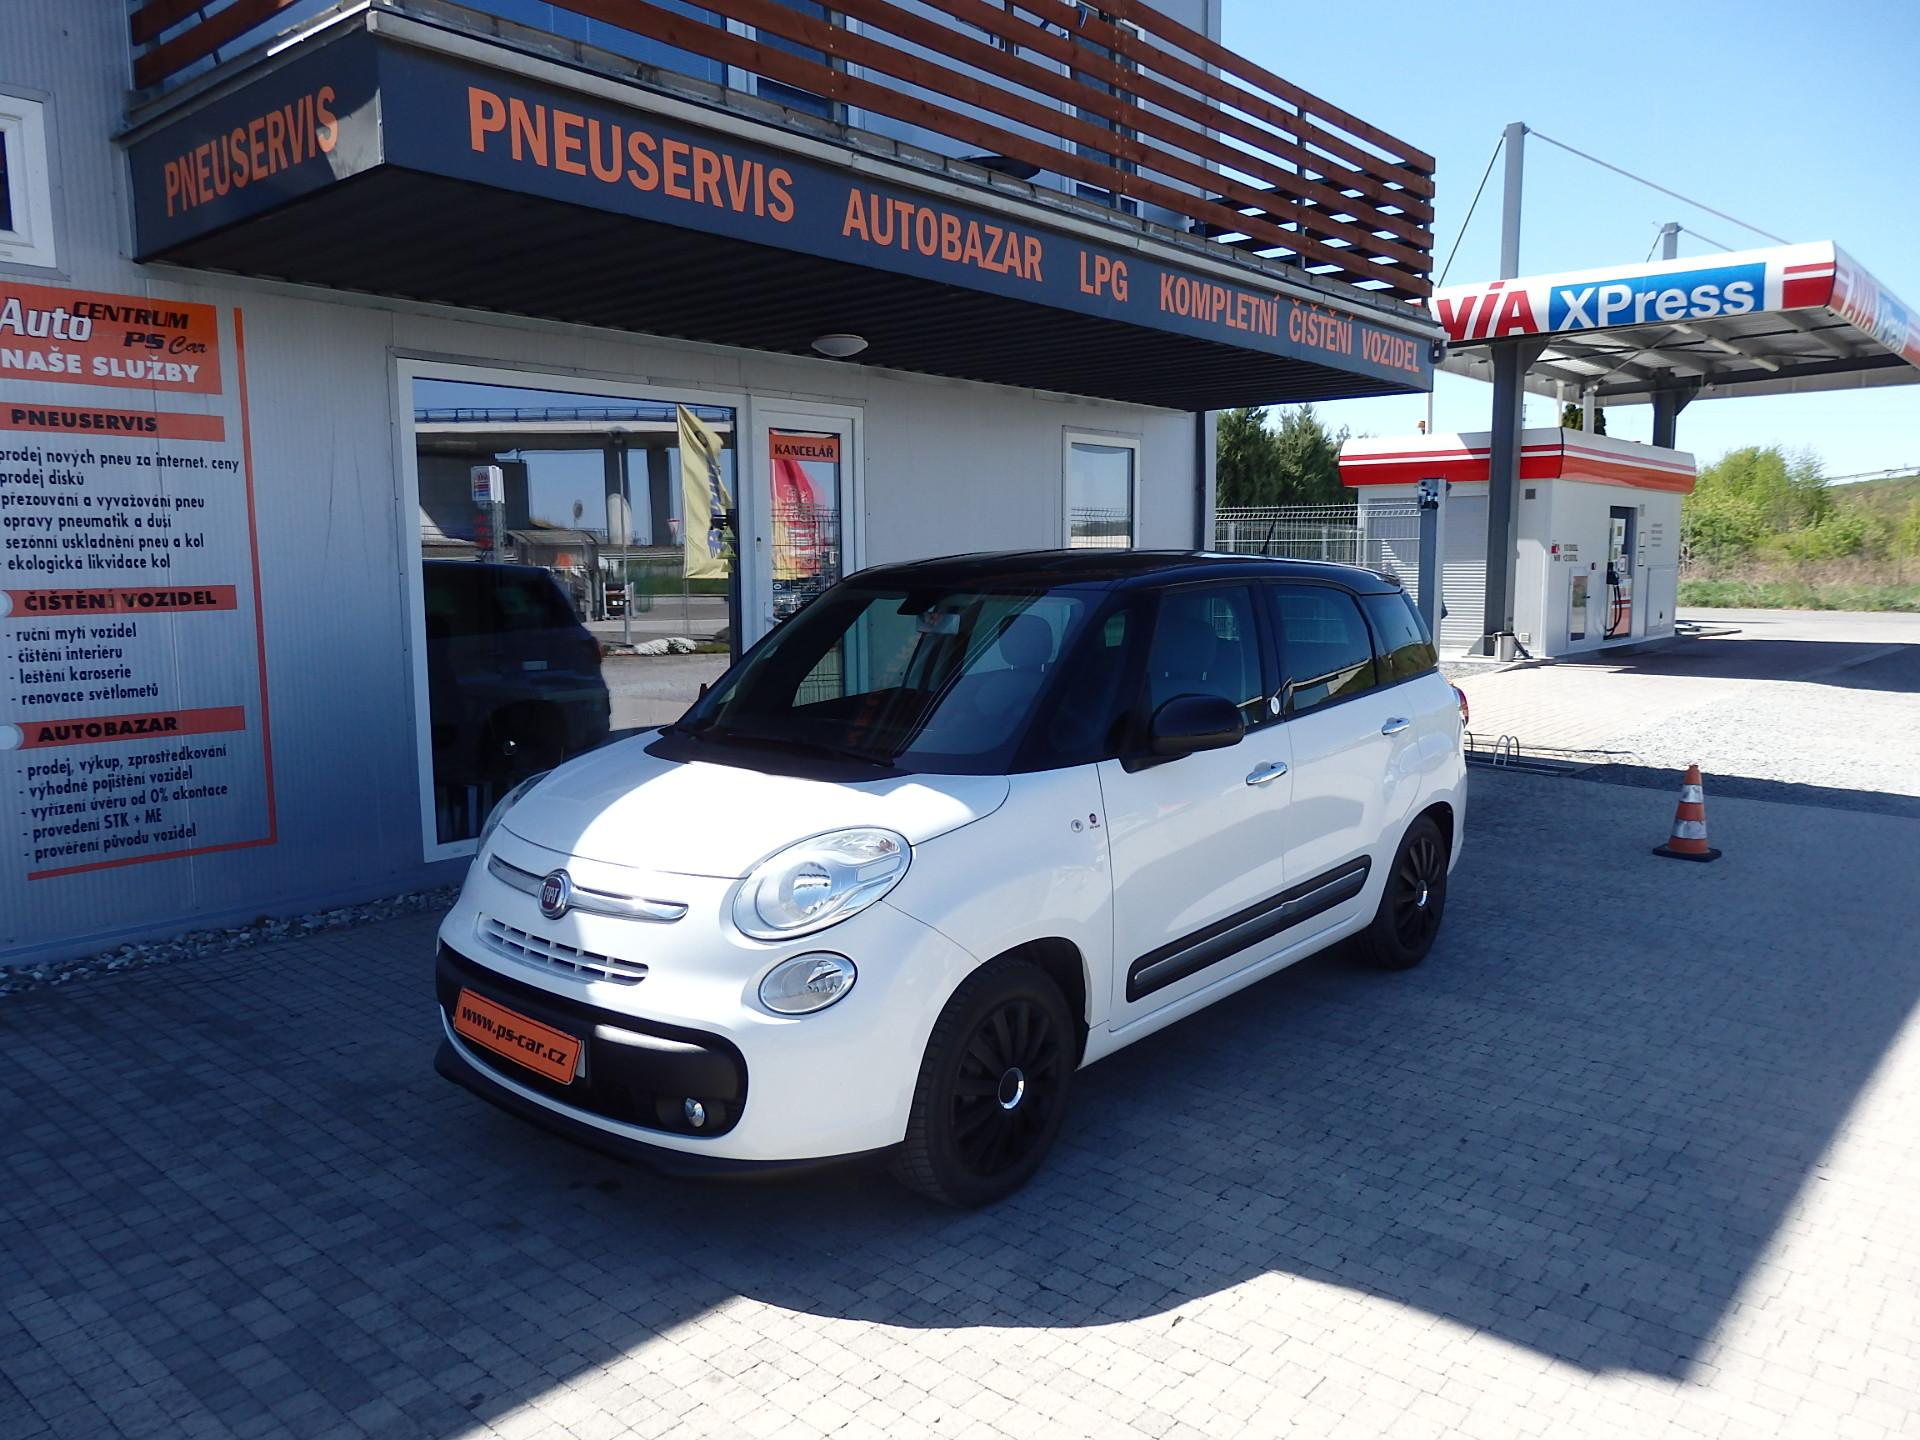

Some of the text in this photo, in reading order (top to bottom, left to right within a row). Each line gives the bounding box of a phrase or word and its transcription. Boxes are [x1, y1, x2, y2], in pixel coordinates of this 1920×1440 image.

[163, 86, 339, 217] PNEUSERVIS
[468, 86, 1420, 373] PNEUSERVIS AUTOBAZAR LPG KOMPLETNÍ ČIŠTĚNÍ VOZIDEL
[0, 296, 93, 342] Auto
[73, 301, 190, 329] CENTRUM
[1436, 279, 1755, 341] VIA XPress
[123, 331, 208, 355] PS Car
[0, 345, 200, 383] NAŠE SLUŽBY
[11, 408, 158, 432] PNEUSERVIS
[46, 448, 95, 468] nových
[100, 453, 131, 468] pneu
[136, 455, 152, 467] za
[211, 459, 239, 474] ceny
[774, 443, 834, 458] KANCELÁŘ
[0, 468, 44, 488] prodej
[83, 496, 92, 506] a
[175, 497, 204, 511] pneu
[3, 517, 53, 531] opravy
[58, 512, 129, 531] pneumatik
[134, 517, 142, 527] a
[139, 537, 169, 551] pneu
[173, 538, 181, 547] a
[185, 532, 204, 548] kol
[88, 553, 147, 570] likvidace
[151, 553, 170, 568] kol
[24, 590, 217, 611] ČIŠTĚNÍ VOZIDEL
[90, 622, 137, 639] vozidel
[69, 664, 132, 681] karoserie
[21, 690, 84, 706] renovace
[38, 716, 178, 743] AUTOBAZAR
[150, 765, 193, 784] vozidel
[131, 792, 146, 806] od
[150, 787, 169, 804] 0%
[173, 784, 228, 801] akontace
[104, 812, 130, 829] STK
[145, 807, 163, 824] ME
[153, 823, 197, 842] vozidel
[543, 885, 560, 904] FIAT
[461, 1006, 568, 1067] www.ps-car.cz
